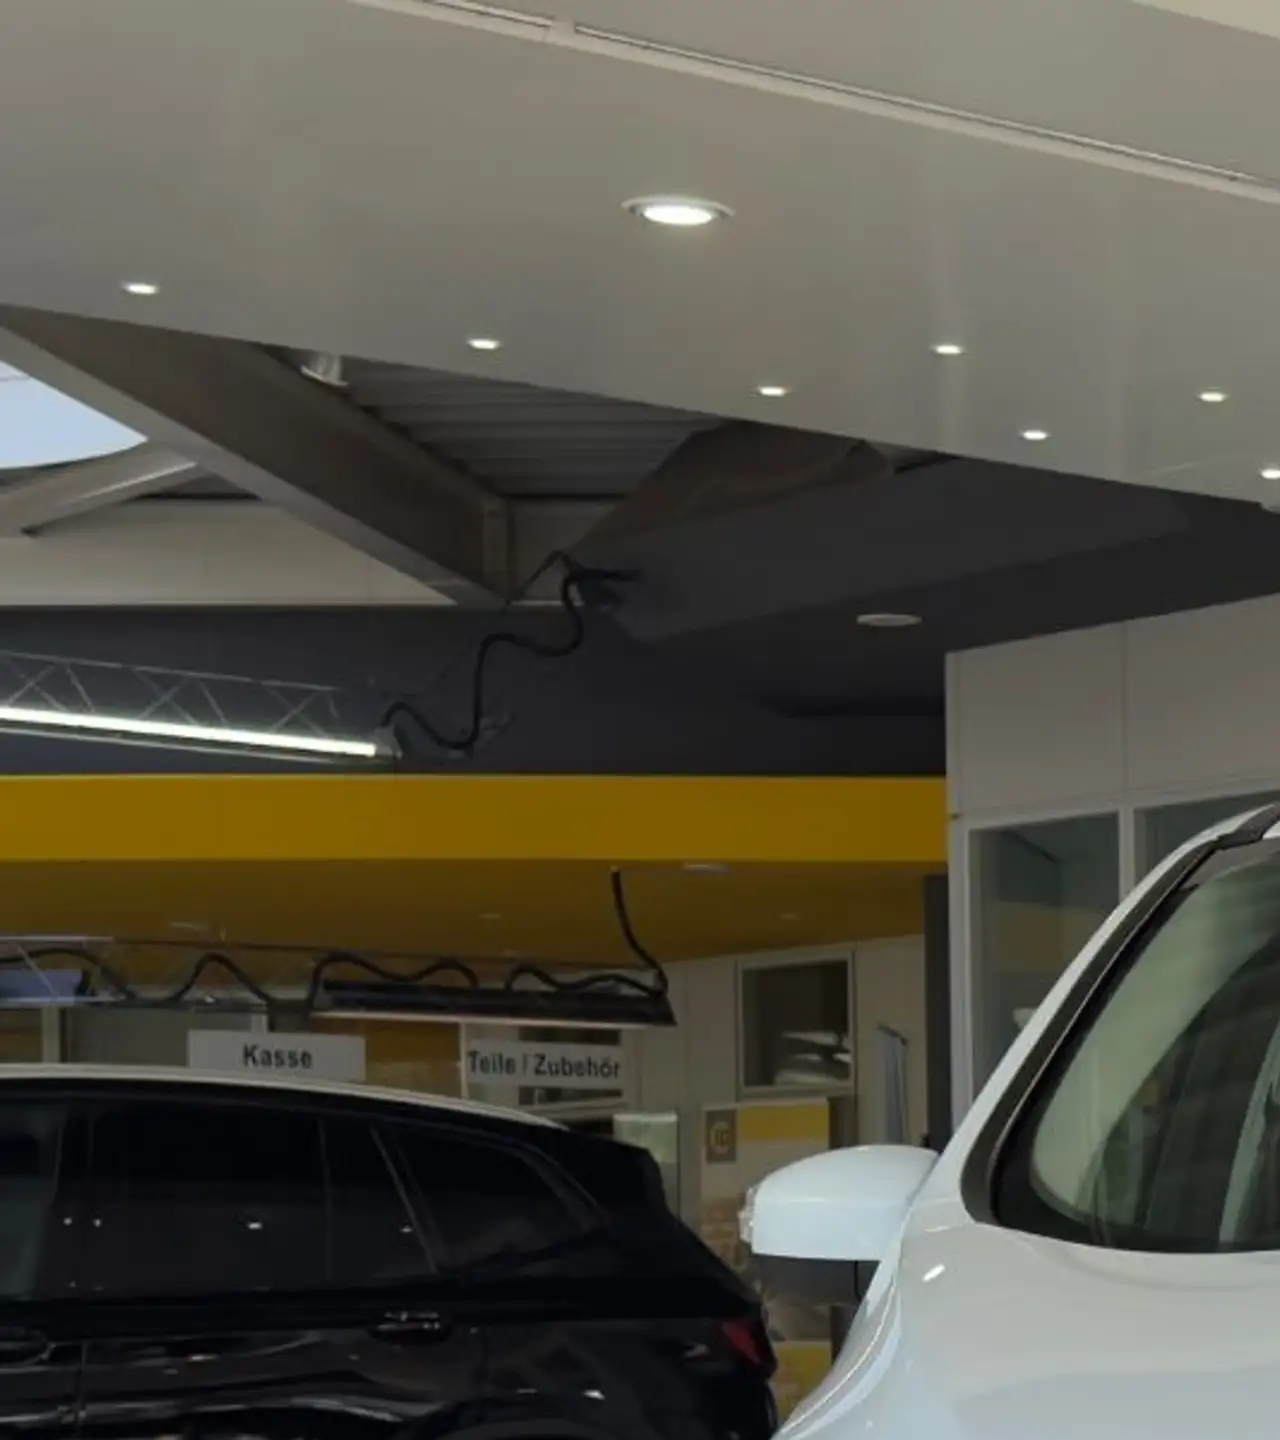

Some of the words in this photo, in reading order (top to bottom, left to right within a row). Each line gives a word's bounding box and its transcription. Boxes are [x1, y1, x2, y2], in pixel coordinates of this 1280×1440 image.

[243, 1043, 314, 1069] Kasse
[468, 1050, 517, 1077] Teile
[534, 1053, 620, 1079] Zubehör
